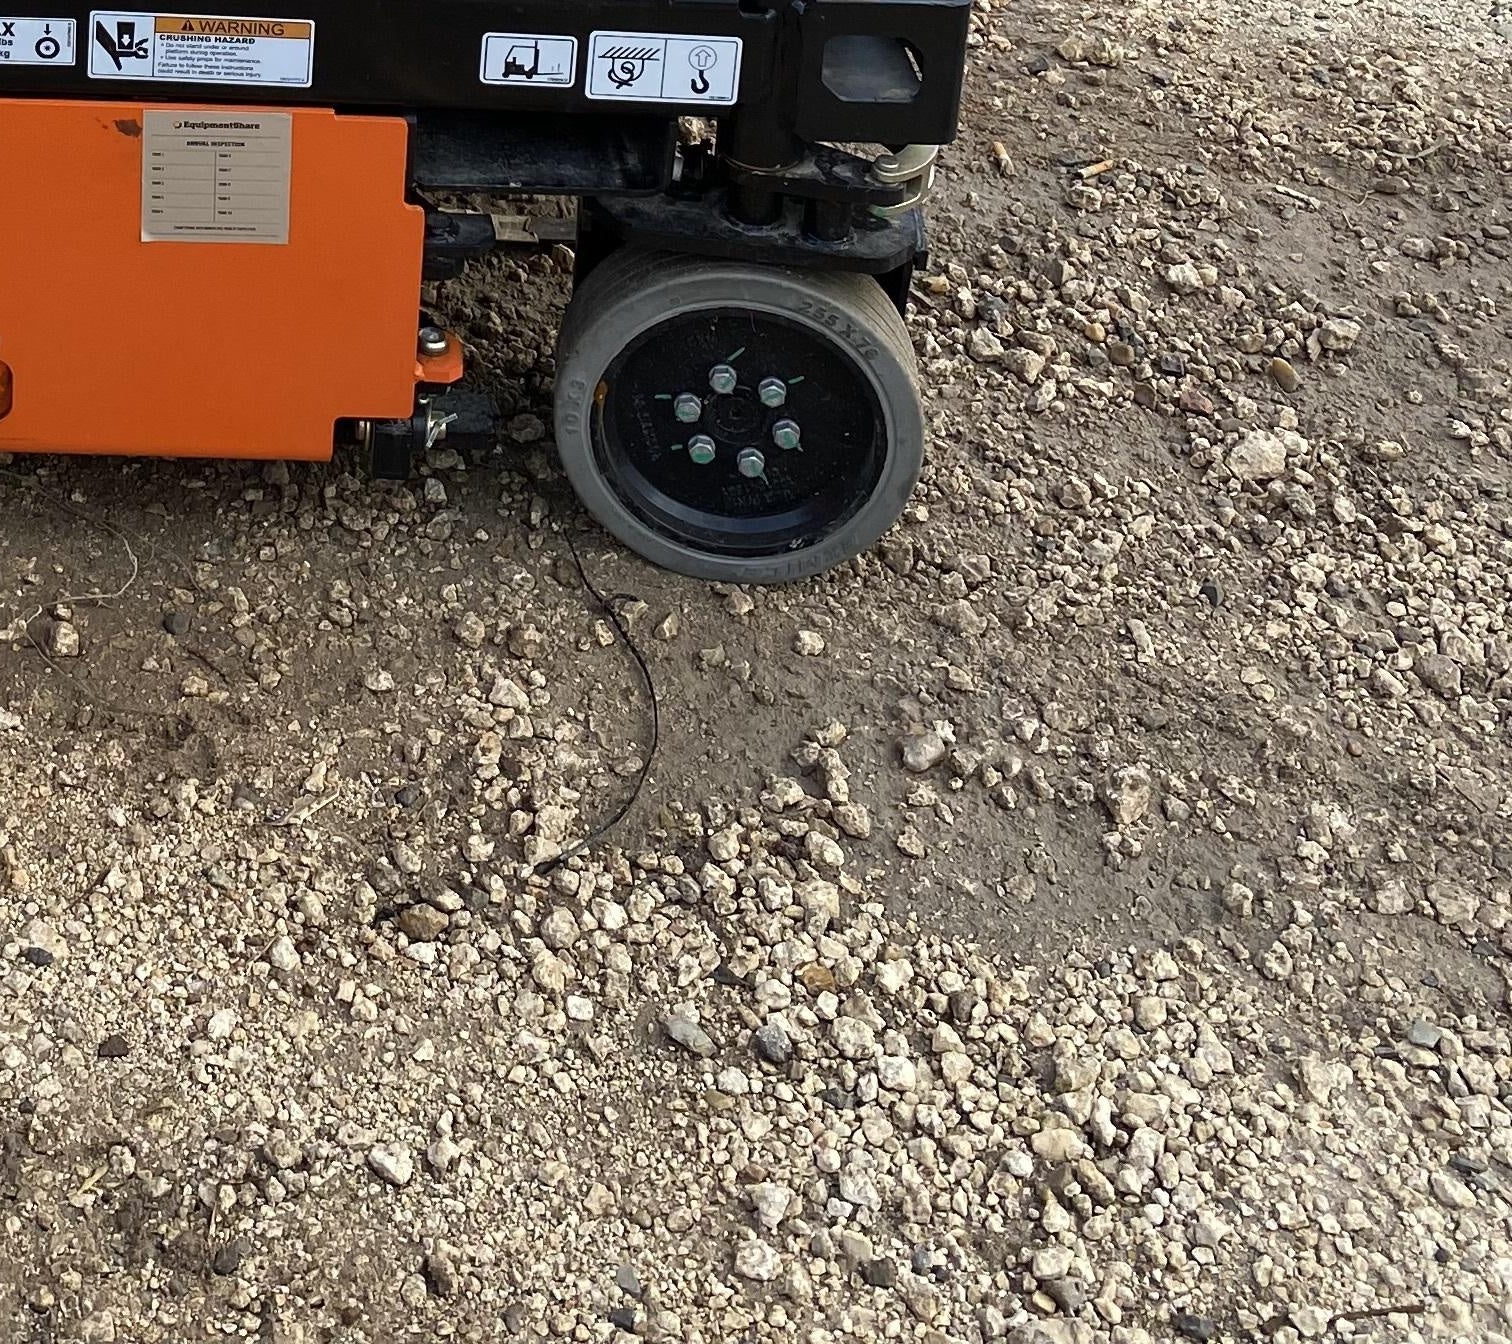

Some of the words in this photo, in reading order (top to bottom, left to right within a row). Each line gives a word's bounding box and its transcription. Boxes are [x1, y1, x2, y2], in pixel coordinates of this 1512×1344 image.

[199, 20, 285, 36] WARNING
[160, 34, 212, 43] CRUSHING
[214, 36, 256, 44] HAZARD
[183, 120, 261, 131] EquipmentShare
